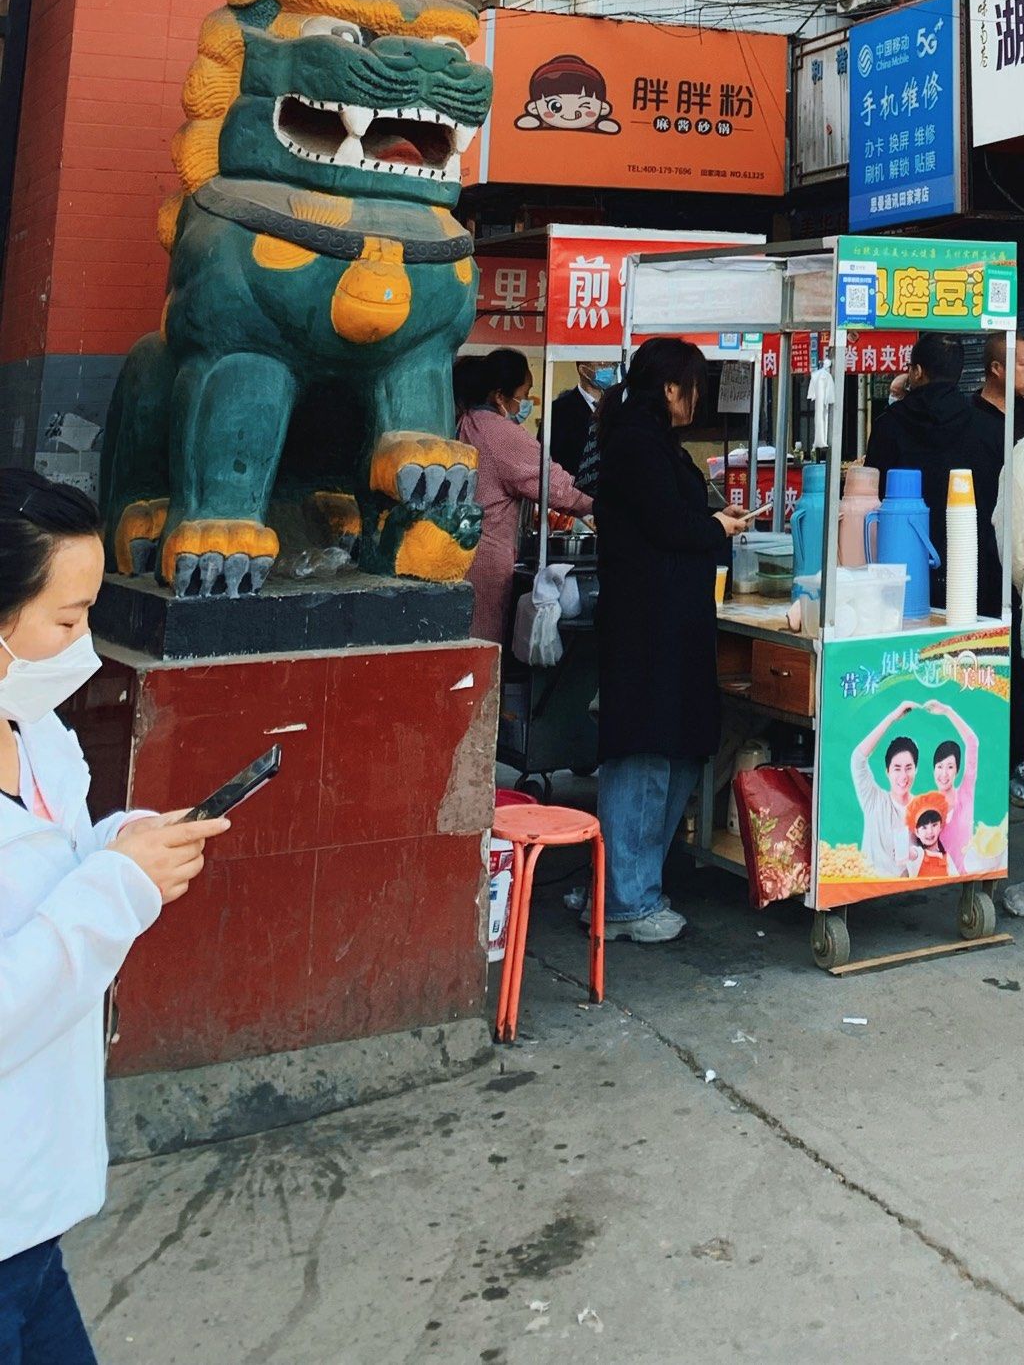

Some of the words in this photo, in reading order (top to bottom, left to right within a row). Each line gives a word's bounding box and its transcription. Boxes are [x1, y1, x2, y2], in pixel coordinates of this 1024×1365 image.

[876, 34, 910, 58] 中国移动
[632, 77, 754, 118] 胖胖粉
[860, 70, 943, 126] 手机维修
[865, 137, 885, 158] 办卡
[889, 131, 910, 154] 换屏
[914, 124, 936, 147] 维修
[865, 163, 885, 185] 刷机
[889, 157, 910, 180] 解锁
[914, 151, 936, 174] 贴膜
